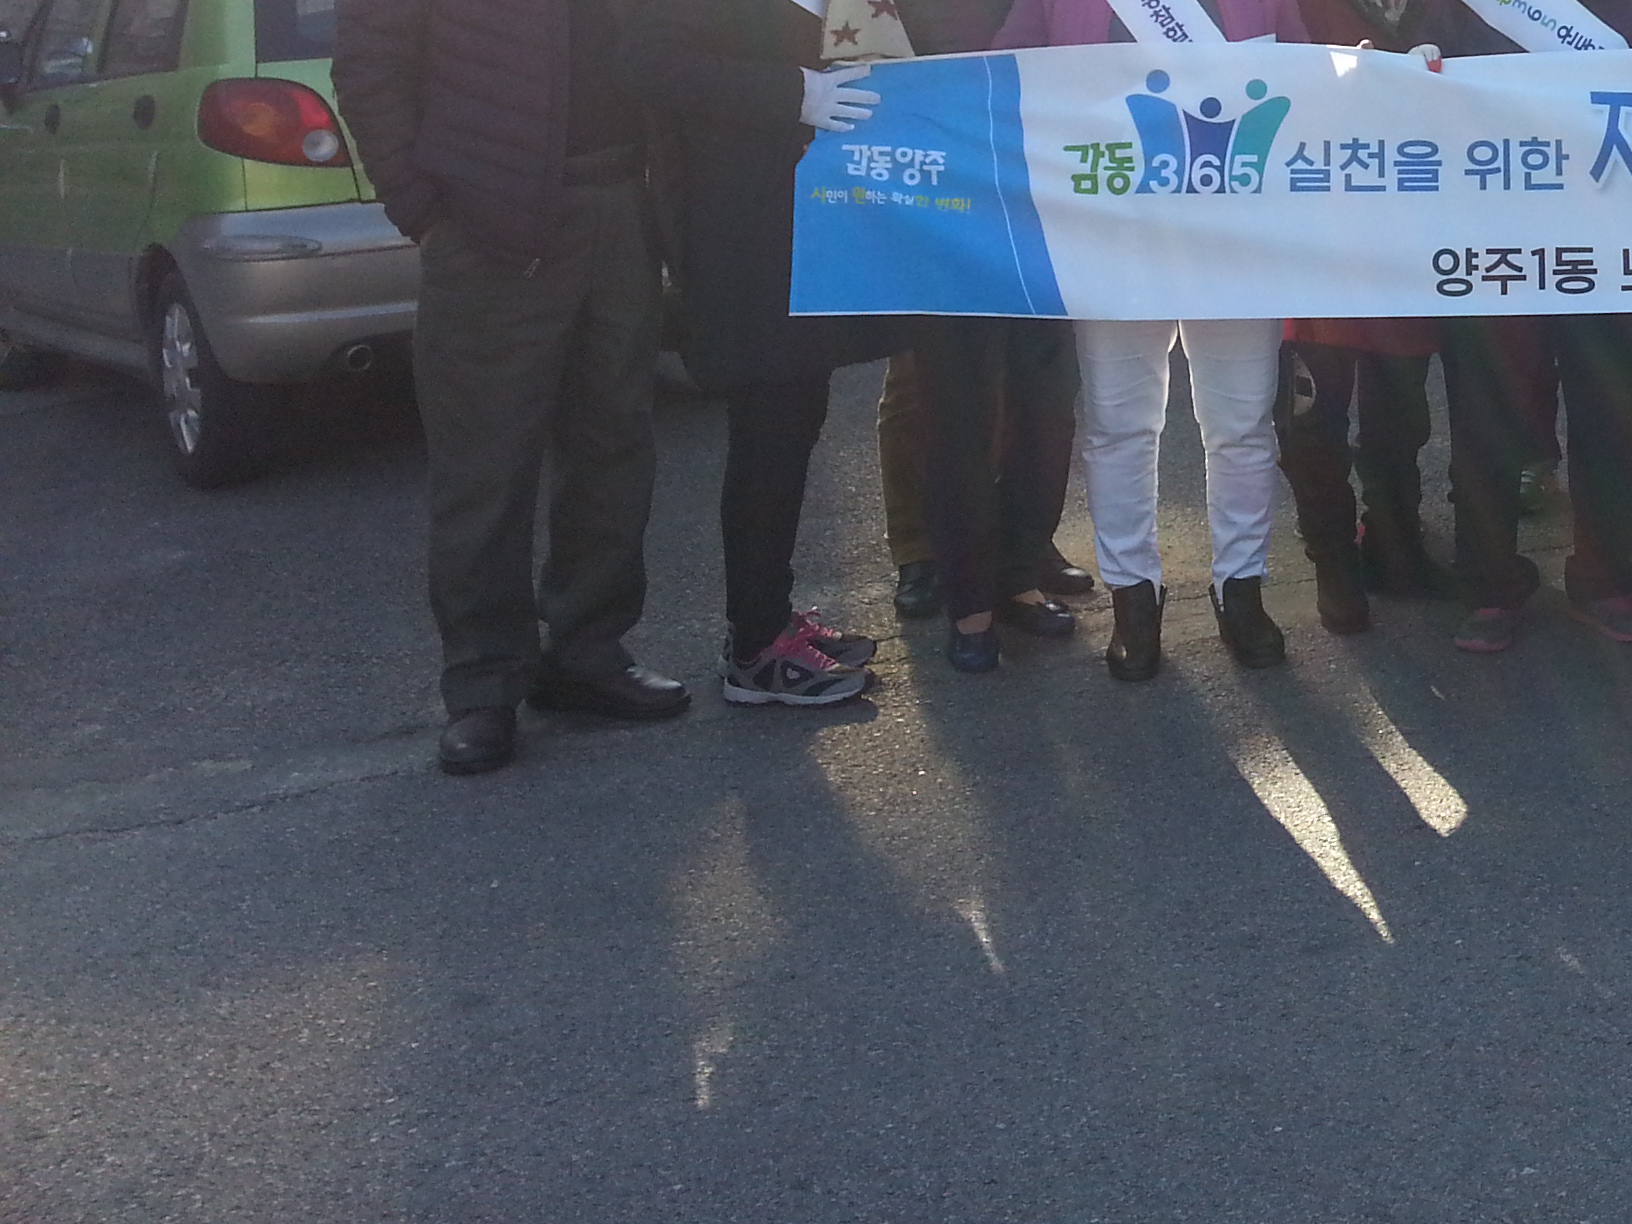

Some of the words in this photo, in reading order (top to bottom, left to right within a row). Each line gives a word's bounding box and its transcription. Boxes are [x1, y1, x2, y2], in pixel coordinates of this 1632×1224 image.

[1062, 142, 1260, 195] 감동365
[1284, 138, 1442, 192] 실천을
[1463, 137, 1570, 191] 위한
[811, 186, 848, 204] 시민이
[852, 186, 887, 205] 원하는
[890, 191, 930, 208] 확실한
[935, 196, 972, 214] 변화!
[1432, 245, 1597, 296] 양주1동
